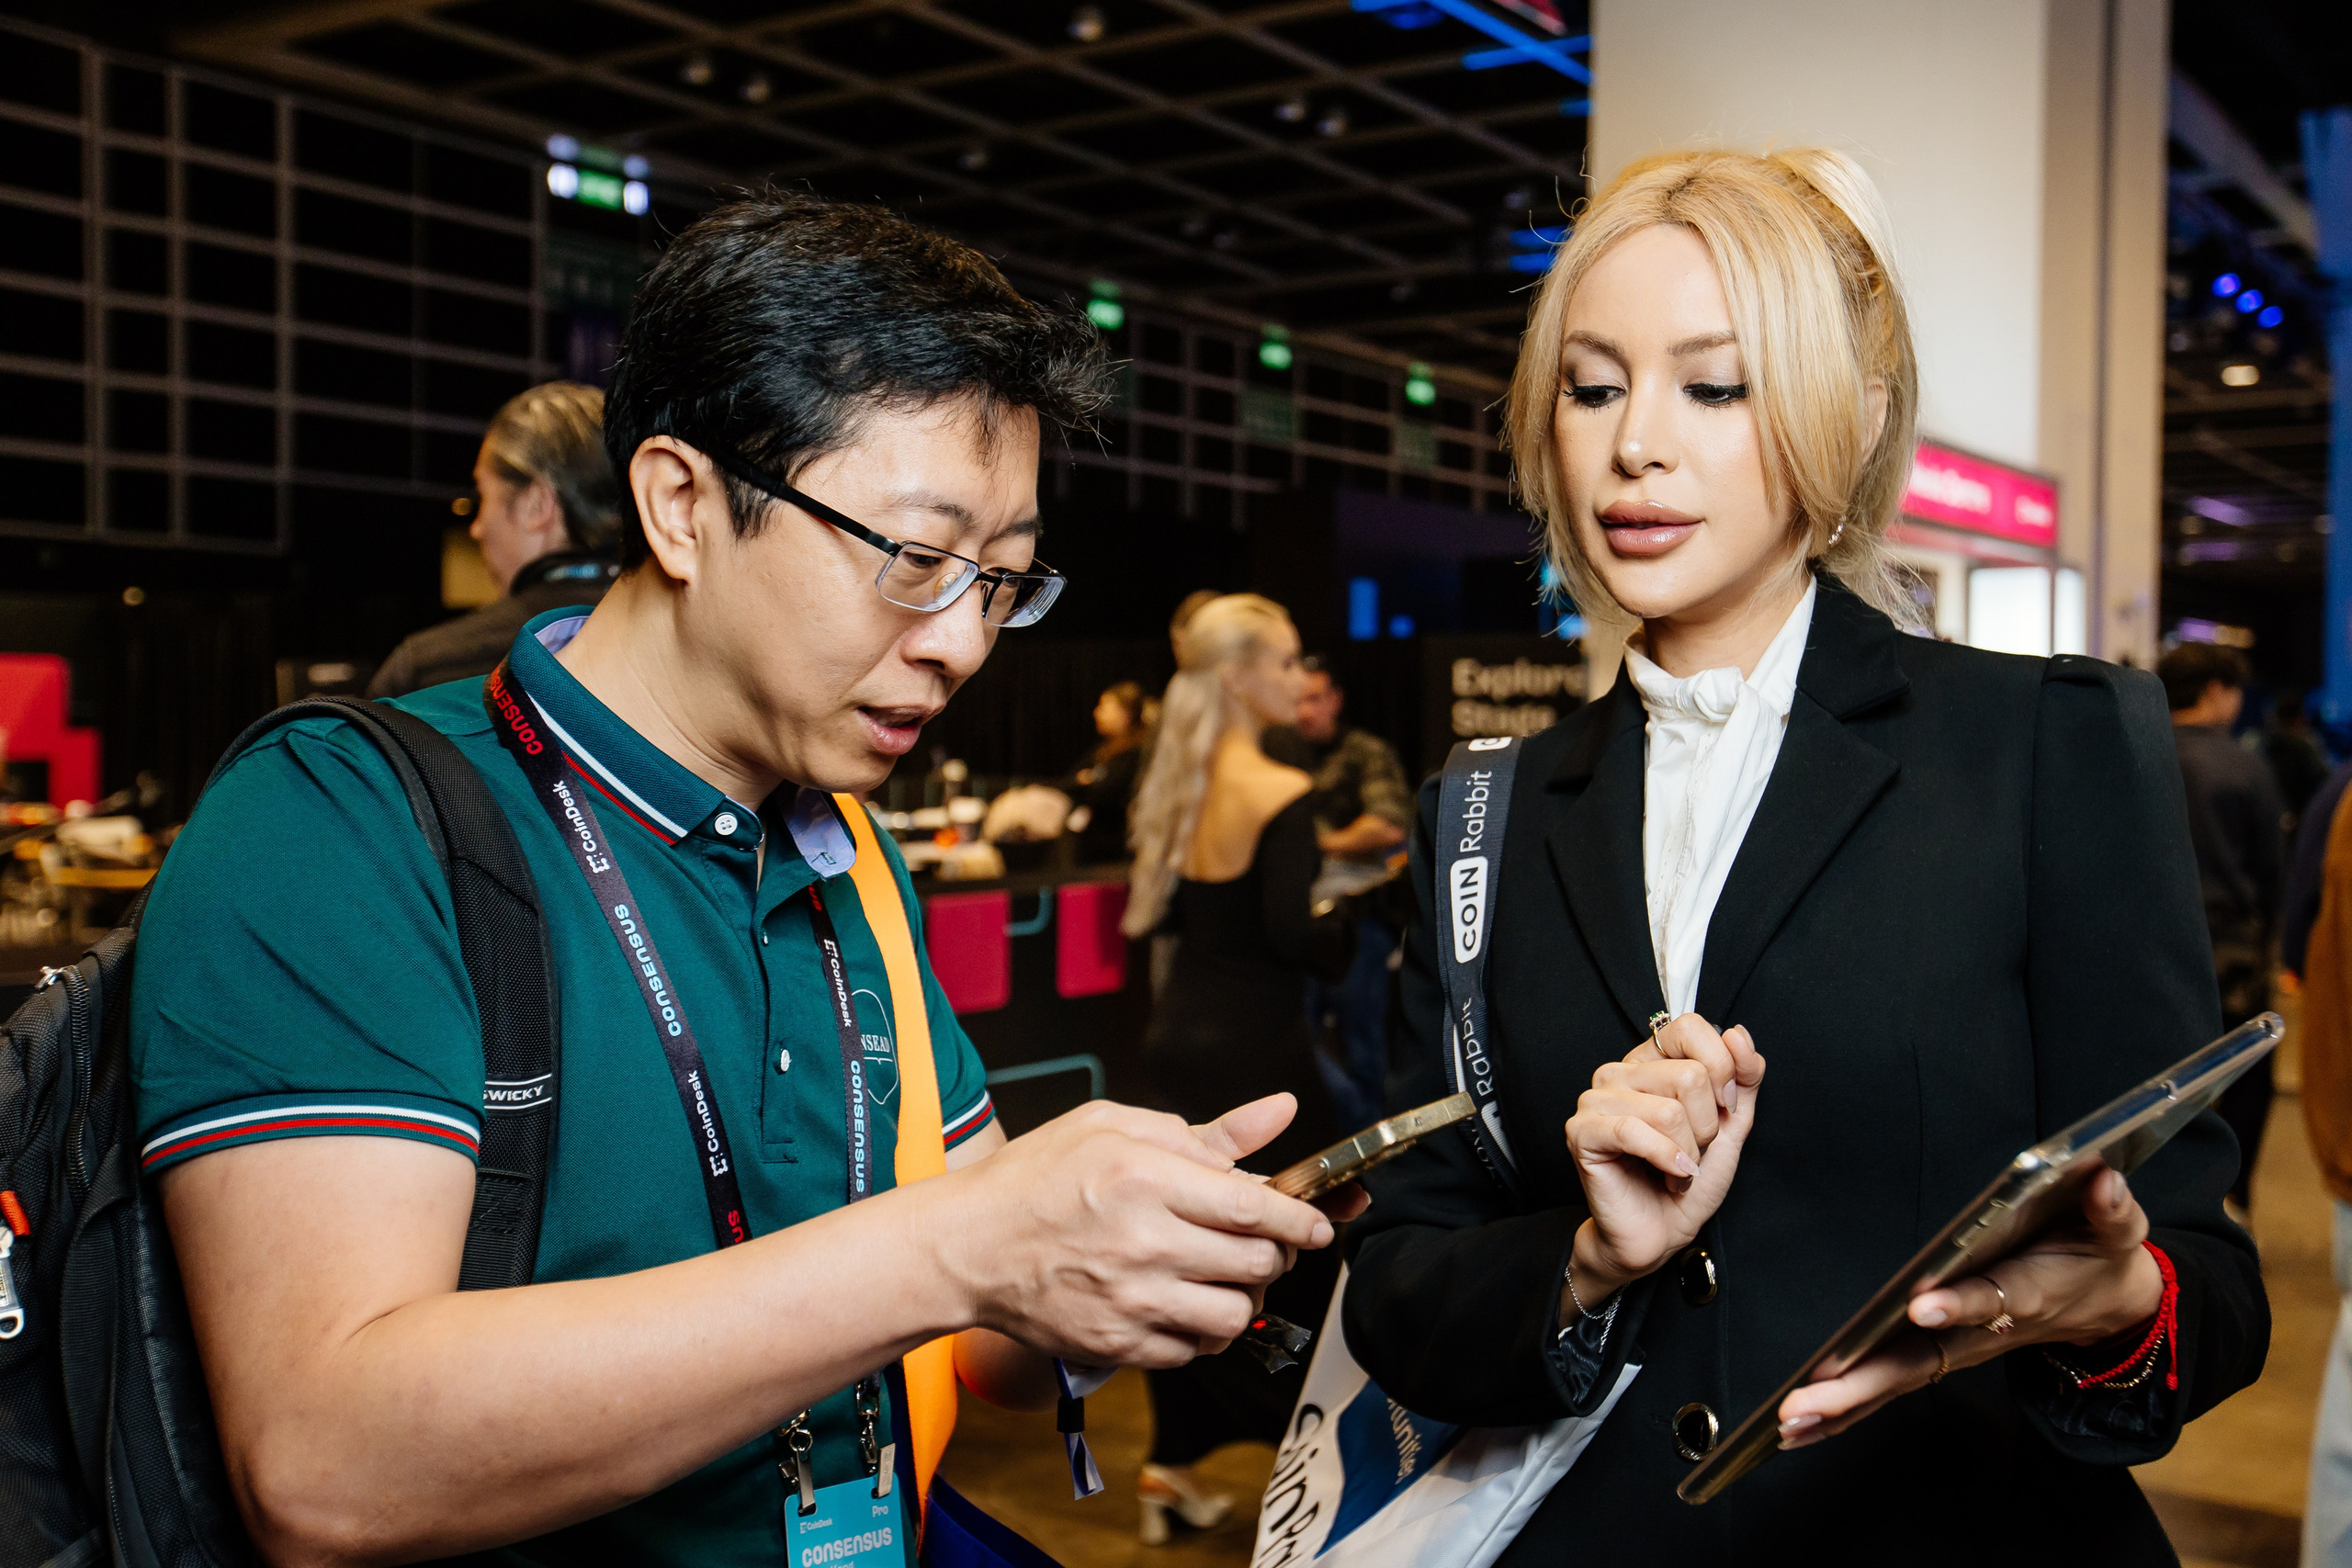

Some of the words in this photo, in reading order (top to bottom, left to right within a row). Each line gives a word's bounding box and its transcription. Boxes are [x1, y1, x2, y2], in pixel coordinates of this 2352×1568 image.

[553, 781, 597, 852] CoinDesk
[1460, 771, 1492, 852] Rabbit
[1459, 866, 1479, 951] COIN
[615, 903, 683, 1037] CONSENSUS
[831, 957, 852, 1028] CoinDesk
[861, 1033, 890, 1053] NSEAD
[1461, 998, 1494, 1098] Rabbit
[688, 1070, 719, 1152] CoinDesk
[851, 1060, 865, 1193] CONSENSUS
[802, 1527, 892, 1568] CONSENSUS
[872, 1506, 888, 1517] Pro
